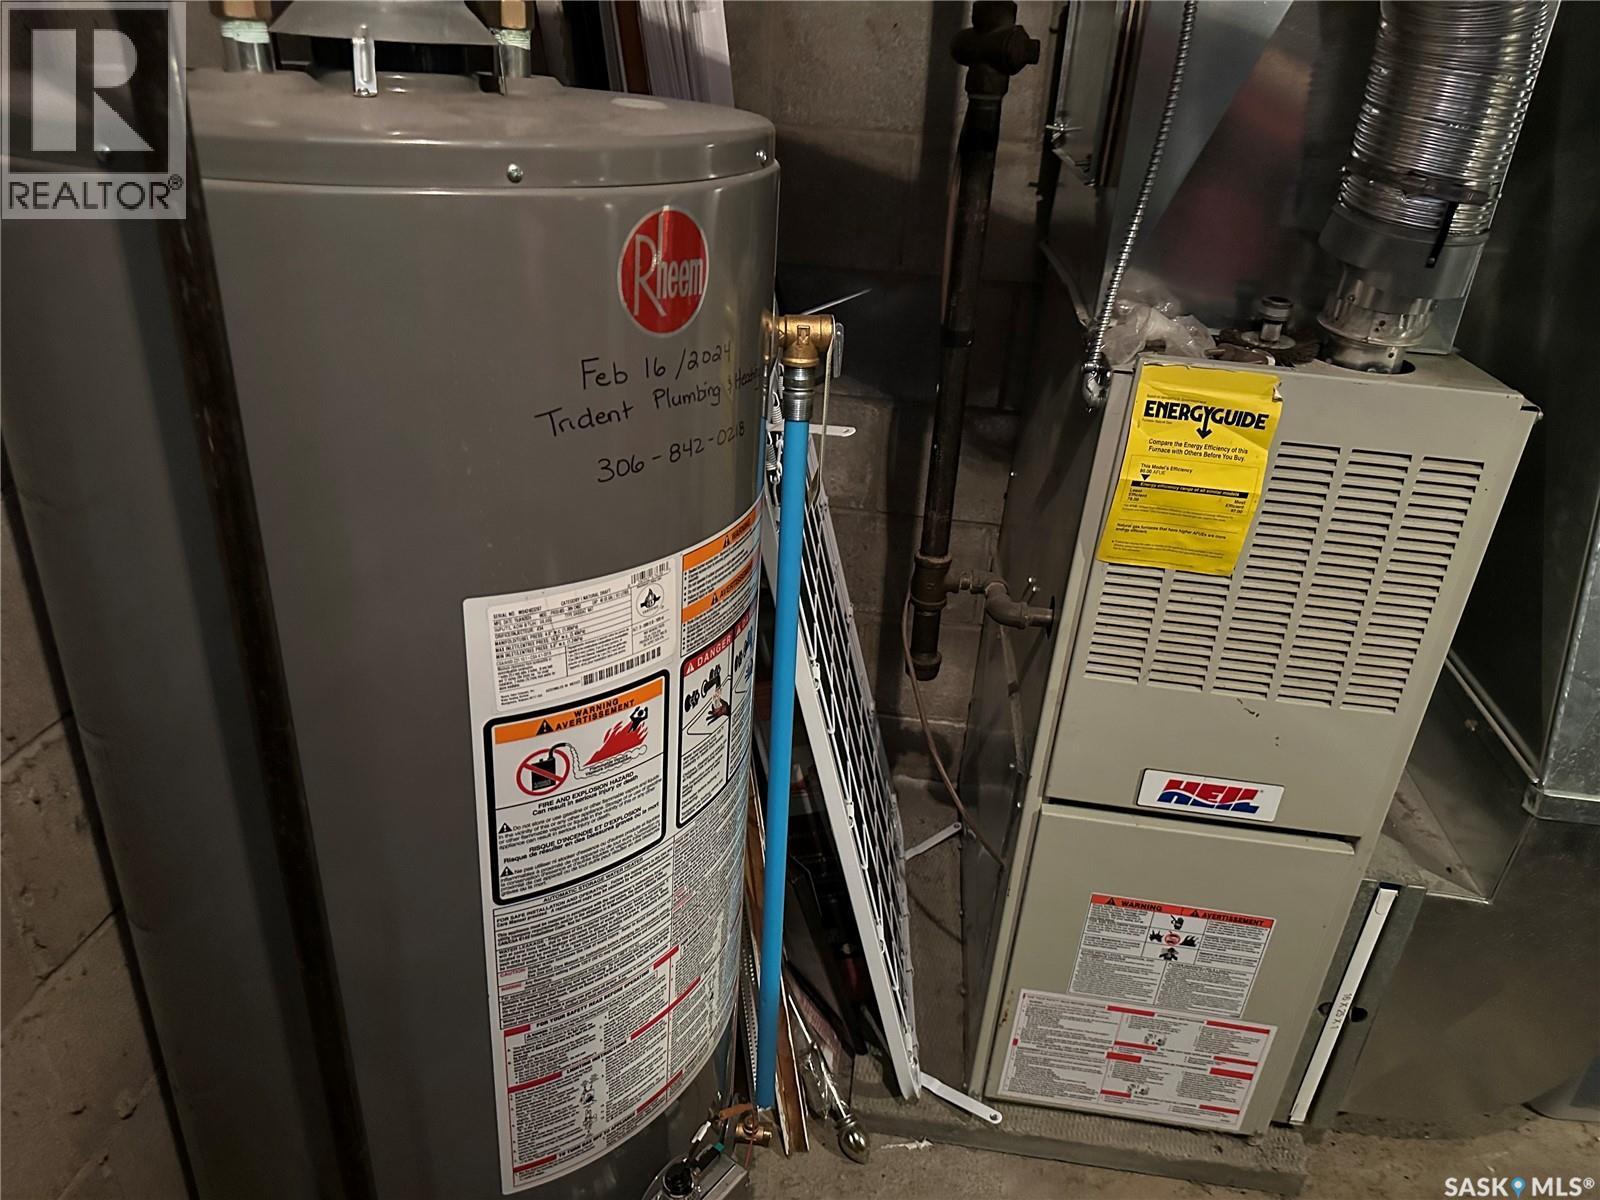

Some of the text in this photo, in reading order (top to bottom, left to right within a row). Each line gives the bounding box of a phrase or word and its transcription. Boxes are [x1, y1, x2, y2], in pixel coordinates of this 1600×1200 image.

[634, 212, 704, 318] Rheem
[580, 357, 628, 390] Feb
[644, 357, 666, 379] 16
[534, 401, 634, 437] Trident
[653, 381, 721, 409] Plumbing
[1143, 399, 1270, 434] ENERGYGUIDE
[1148, 438, 1173, 448] Compare
[1174, 440, 1183, 448] the
[1184, 442, 1203, 451] Energy
[1204, 444, 1231, 454] Efficiency
[1148, 446, 1171, 455] Furnace
[1203, 451, 1221, 459] Before
[1222, 453, 1234, 461] You
[1170, 466, 1193, 474] Efficiency
[697, 635, 732, 666] DANGER
[555, 699, 635, 732] AVERTISSEMENT
[573, 697, 619, 718] WARNING
[538, 771, 634, 809] FIRE AND EXPLOSION HAZARD
[547, 803, 566, 812] result
[575, 793, 597, 804] serious
[598, 786, 615, 795] injury
[623, 775, 639, 785] death
[1157, 778, 1260, 814] HEIL
[503, 854, 527, 864] Risque
[573, 837, 586, 845] des
[586, 825, 615, 840] blessures
[615, 816, 634, 829] graves
[648, 801, 660, 811] mort
[529, 807, 642, 853] RISQUE D'INCENDIE ET D'EXPLOSION
[544, 857, 644, 902] AUTOMATIC STORAGE WATER HEATER
[510, 912, 526, 920] SAFE
[526, 900, 566, 916] INSTALLATION
[578, 883, 608, 899] OPERATION
[1120, 899, 1163, 913] WARNING
[1201, 911, 1266, 927] AVERTISSEMENT
[536, 969, 650, 1028] FOR YOUR SAFETY READ BEFORE OPERATING
